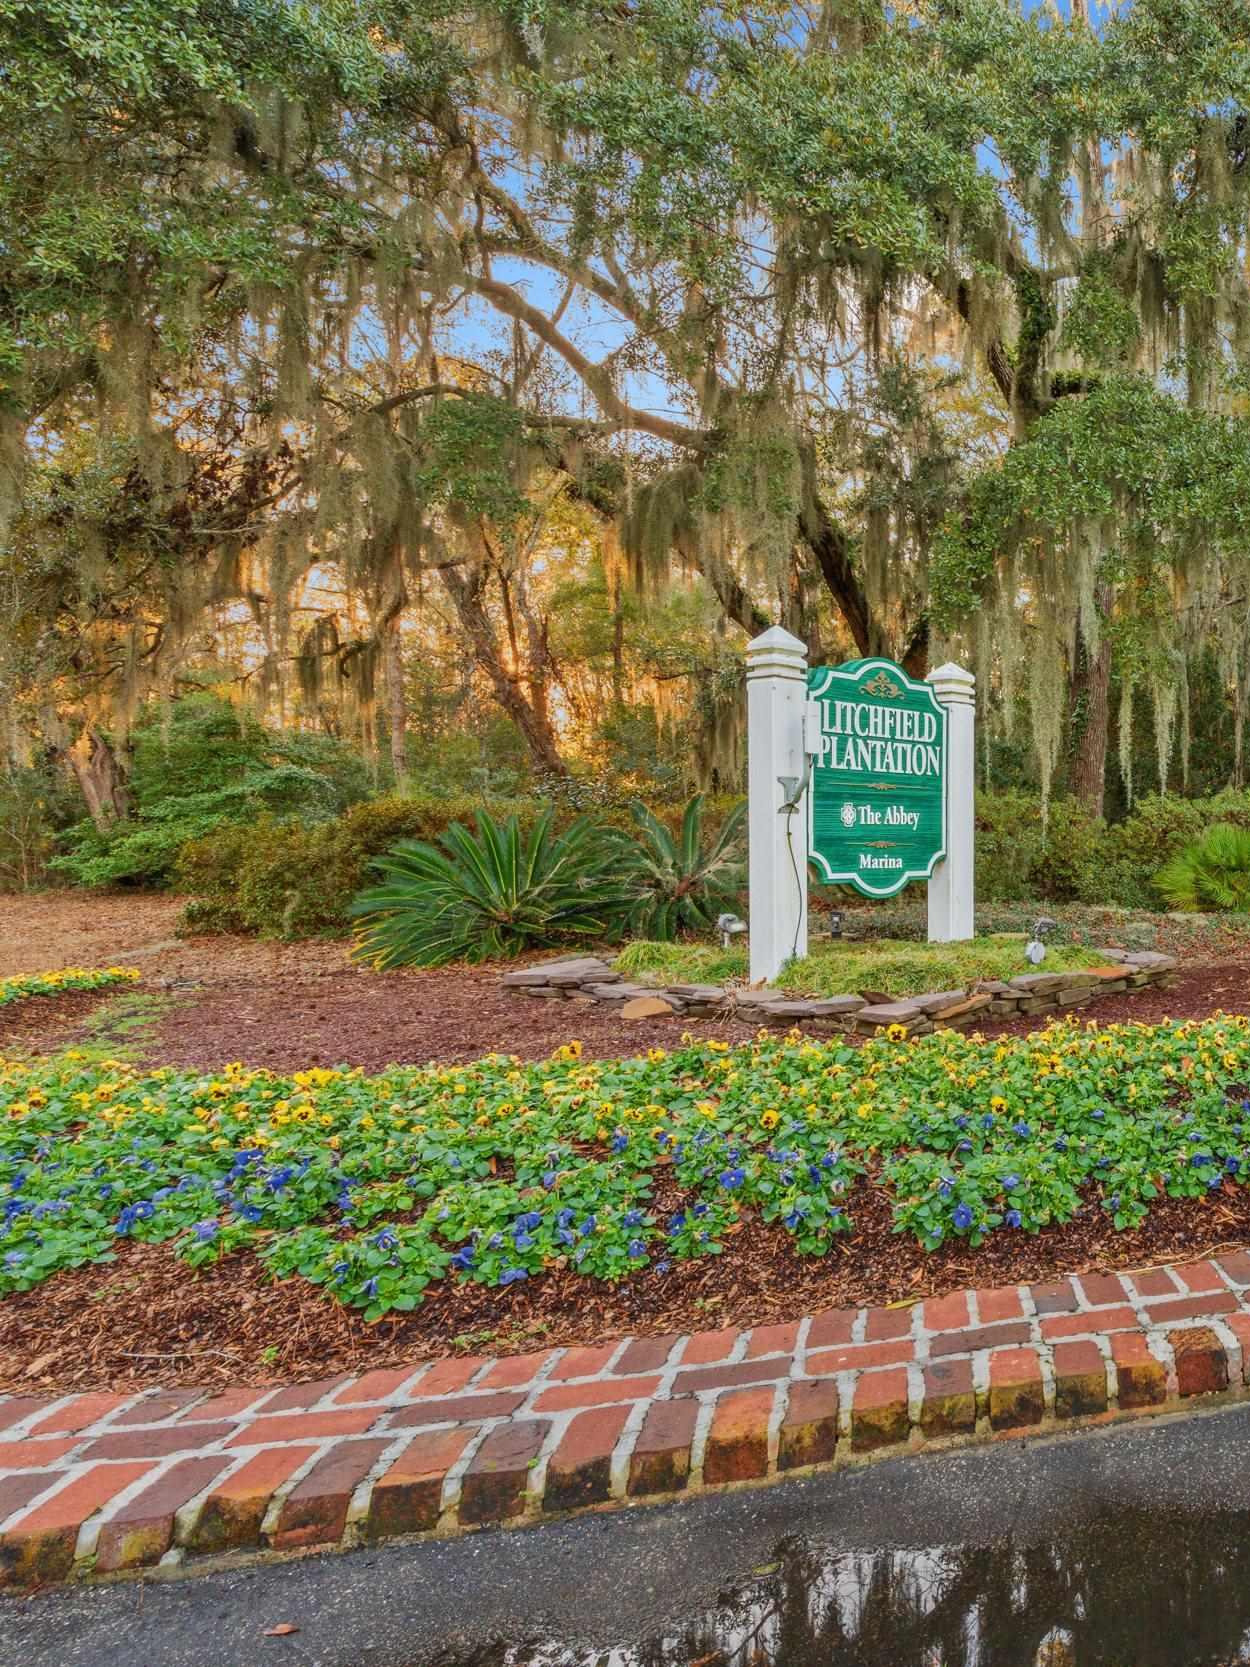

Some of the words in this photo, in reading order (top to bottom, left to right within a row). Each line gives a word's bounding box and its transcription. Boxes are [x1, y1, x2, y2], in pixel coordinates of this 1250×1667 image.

[822, 699, 937, 743] LITCHFIELD
[817, 735, 941, 776] PLANTATION
[858, 805, 882, 825] The
[884, 806, 920, 831] Abbey
[859, 854, 903, 869] Marina
